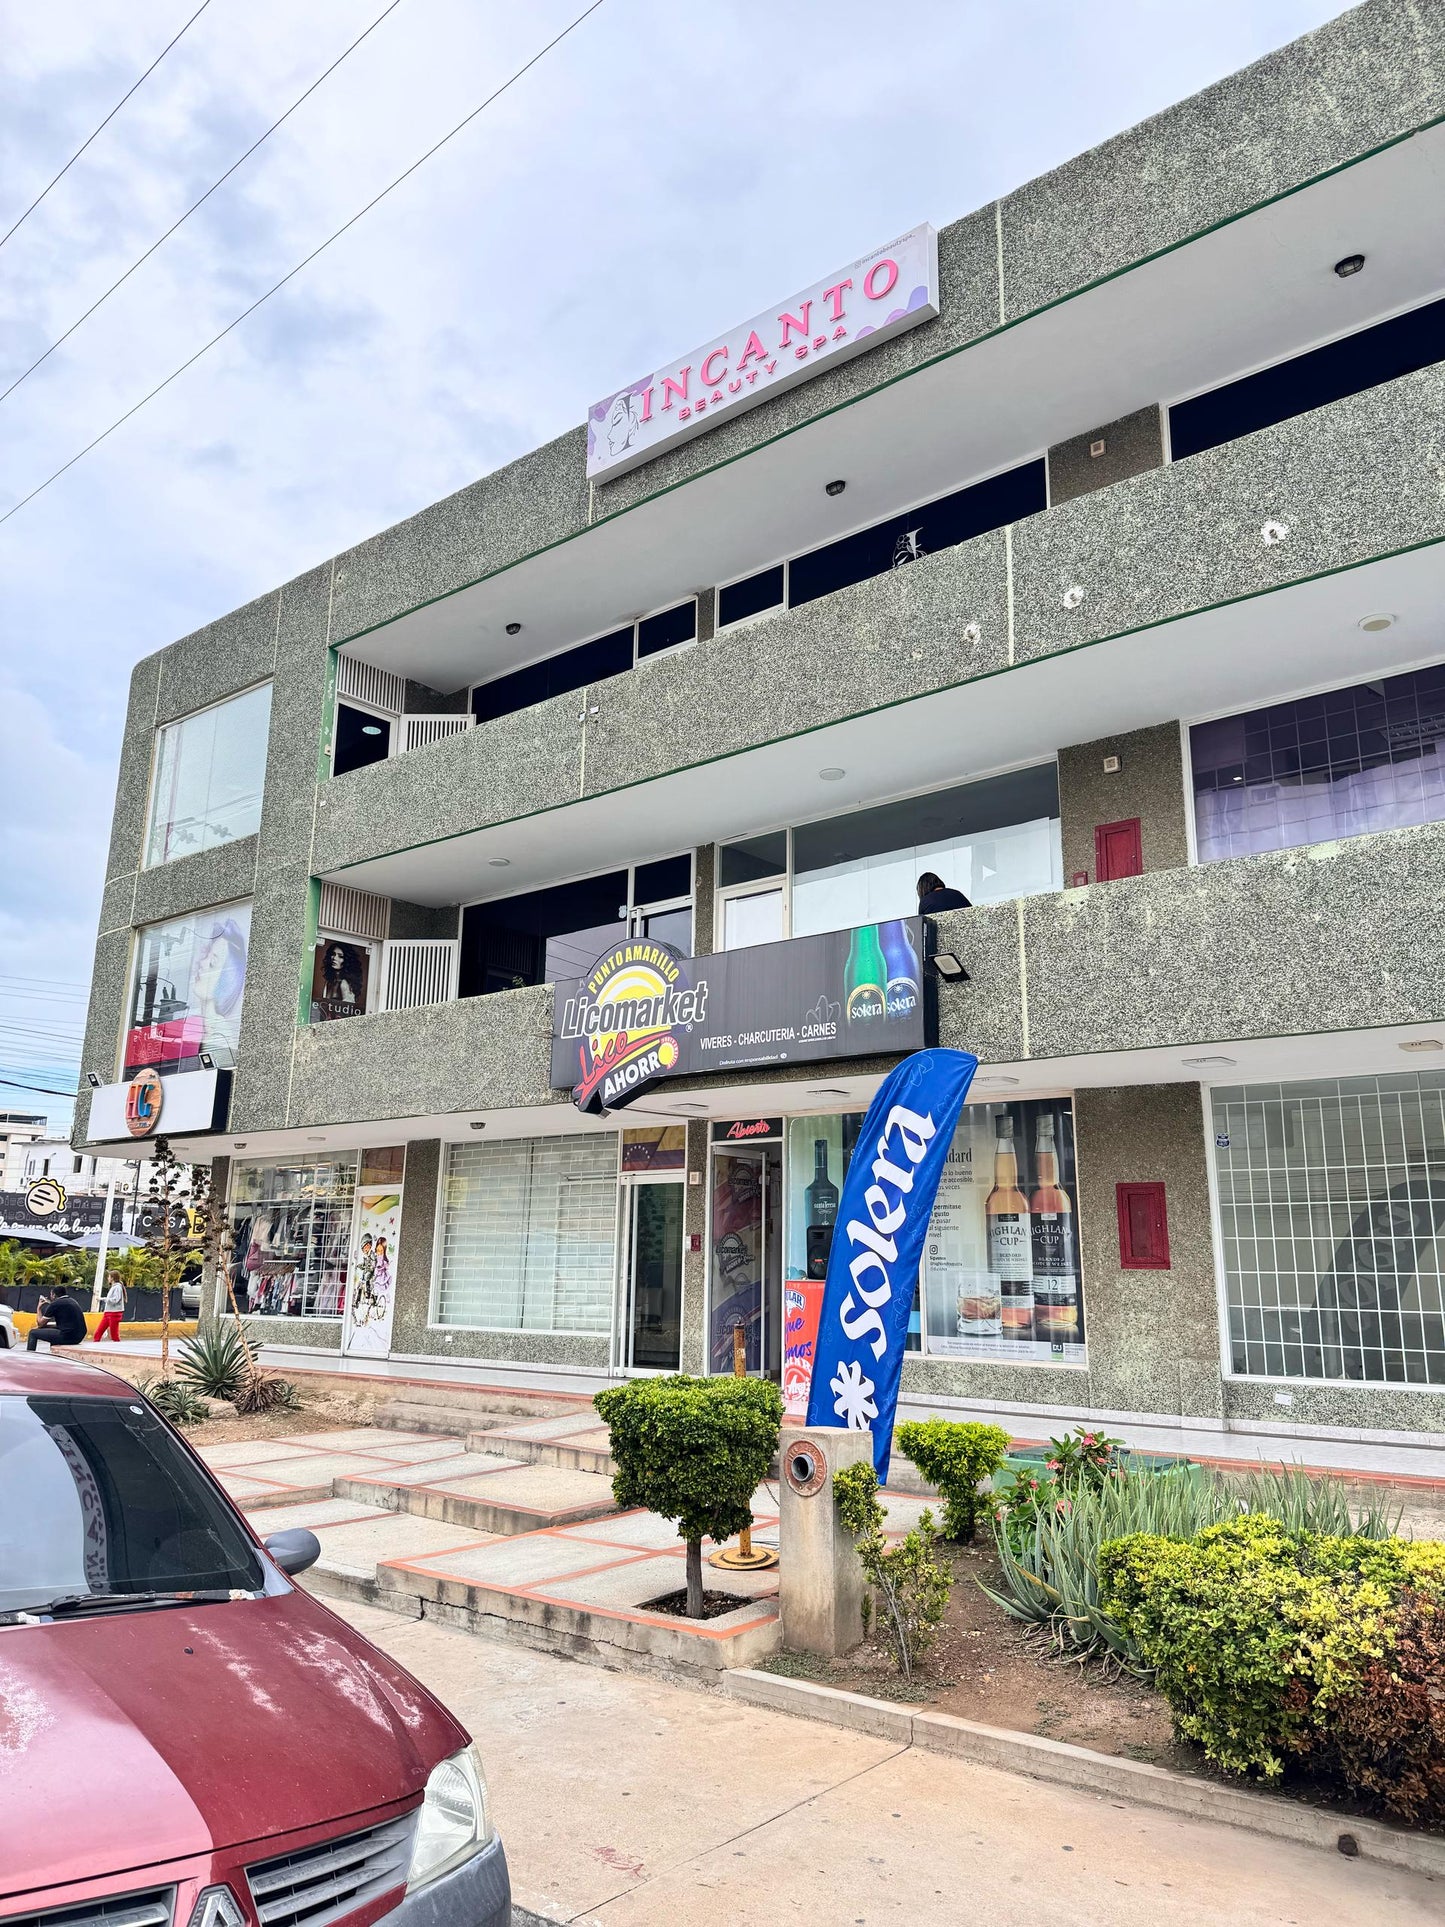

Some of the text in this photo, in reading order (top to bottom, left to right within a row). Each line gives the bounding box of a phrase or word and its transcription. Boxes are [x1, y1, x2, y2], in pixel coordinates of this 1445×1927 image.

[639, 258, 899, 423] INCANTO
[678, 325, 848, 421] BEAUTY SPA
[588, 945, 680, 994] PUNTO AMARILLO
[561, 981, 708, 1039] Licomarket
[851, 1003, 882, 1019] solera
[887, 996, 917, 1014] solera
[700, 1035, 732, 1050] VIVERES
[738, 1028, 795, 1046] CHARCUTERIA
[801, 1022, 837, 1039] CARNES
[142, 1215, 187, 1229] CSA
[934, 1210, 950, 1218] gusto
[47, 1217, 71, 1233] solo
[935, 1224, 960, 1233] siguiente
[839, 1104, 937, 1363] solera
[1000, 1237, 1019, 1246] CUP
[1039, 1235, 1059, 1245] CUP
[1047, 1279, 1058, 1290] 12
